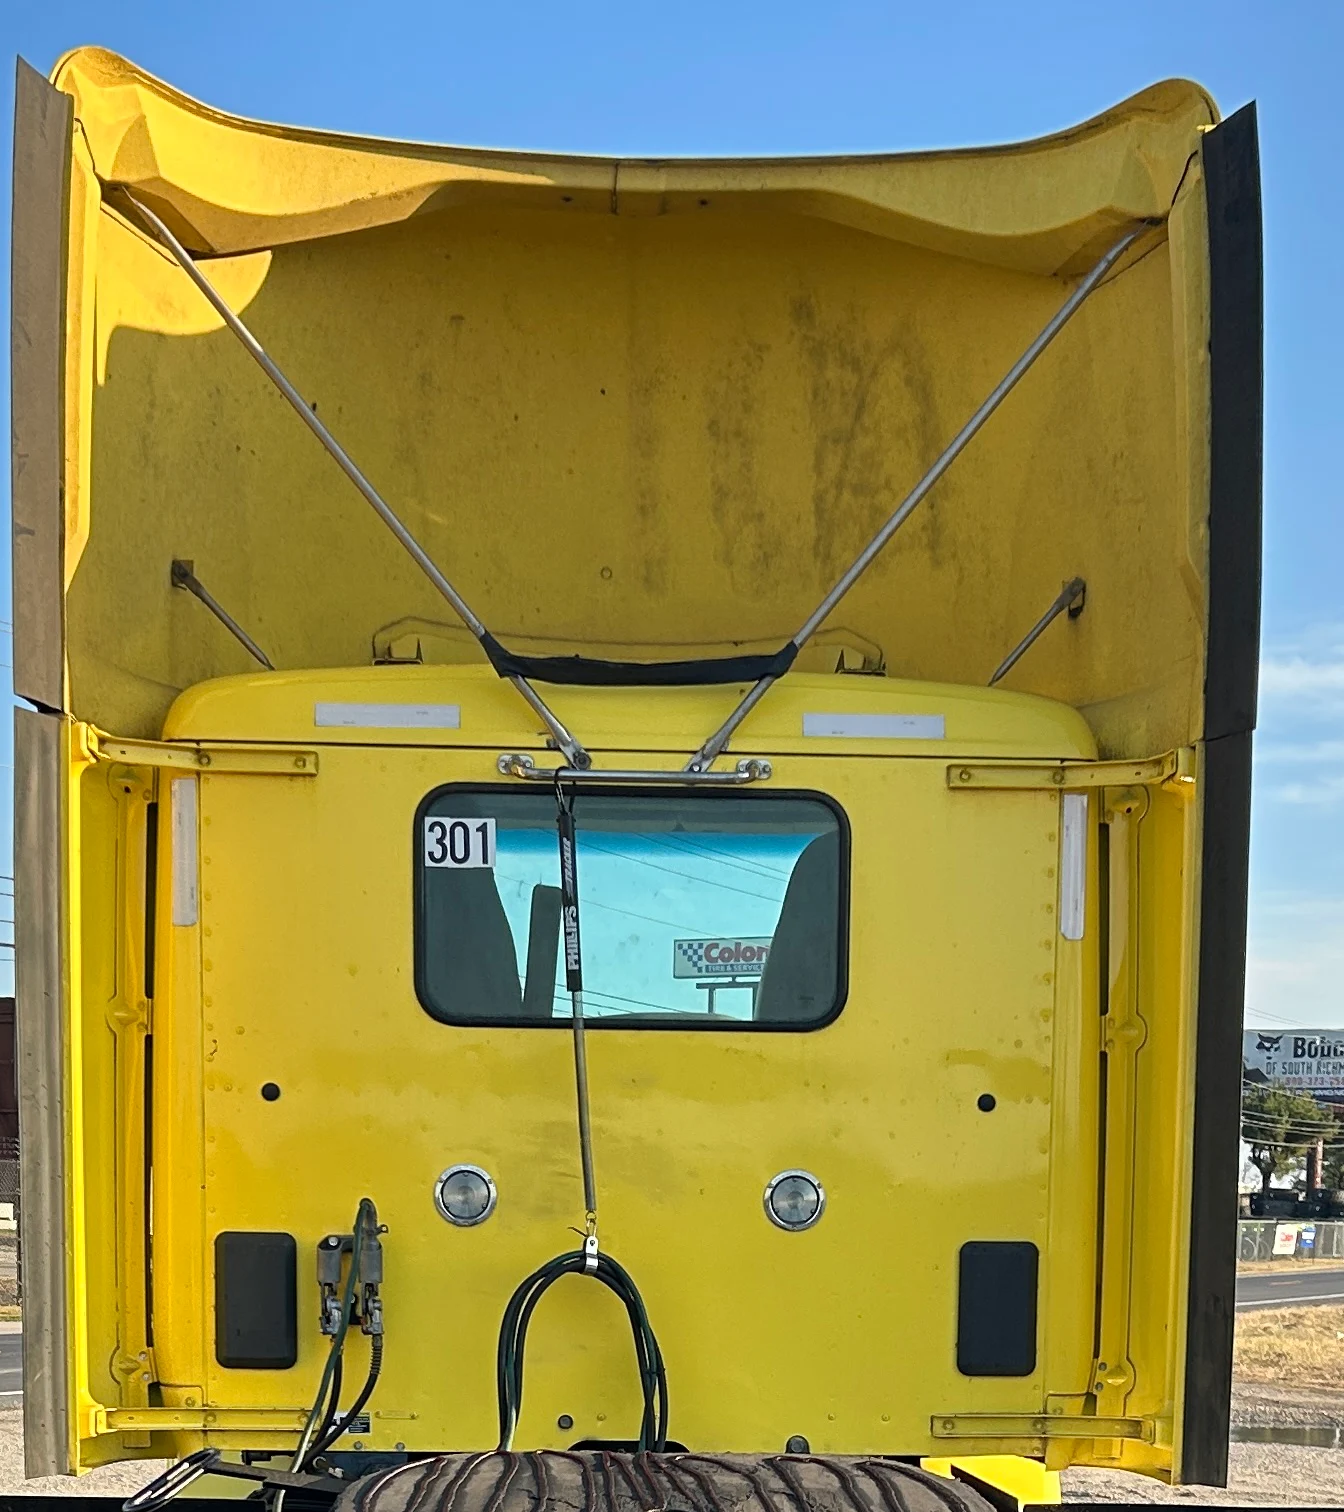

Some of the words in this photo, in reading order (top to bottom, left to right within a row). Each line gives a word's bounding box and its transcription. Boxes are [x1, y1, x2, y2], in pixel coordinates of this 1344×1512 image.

[426, 821, 492, 866] 301
[564, 905, 580, 971] PHILLIPS
[1266, 1062, 1277, 1075] OF
[1282, 1061, 1313, 1076] SOUTH
